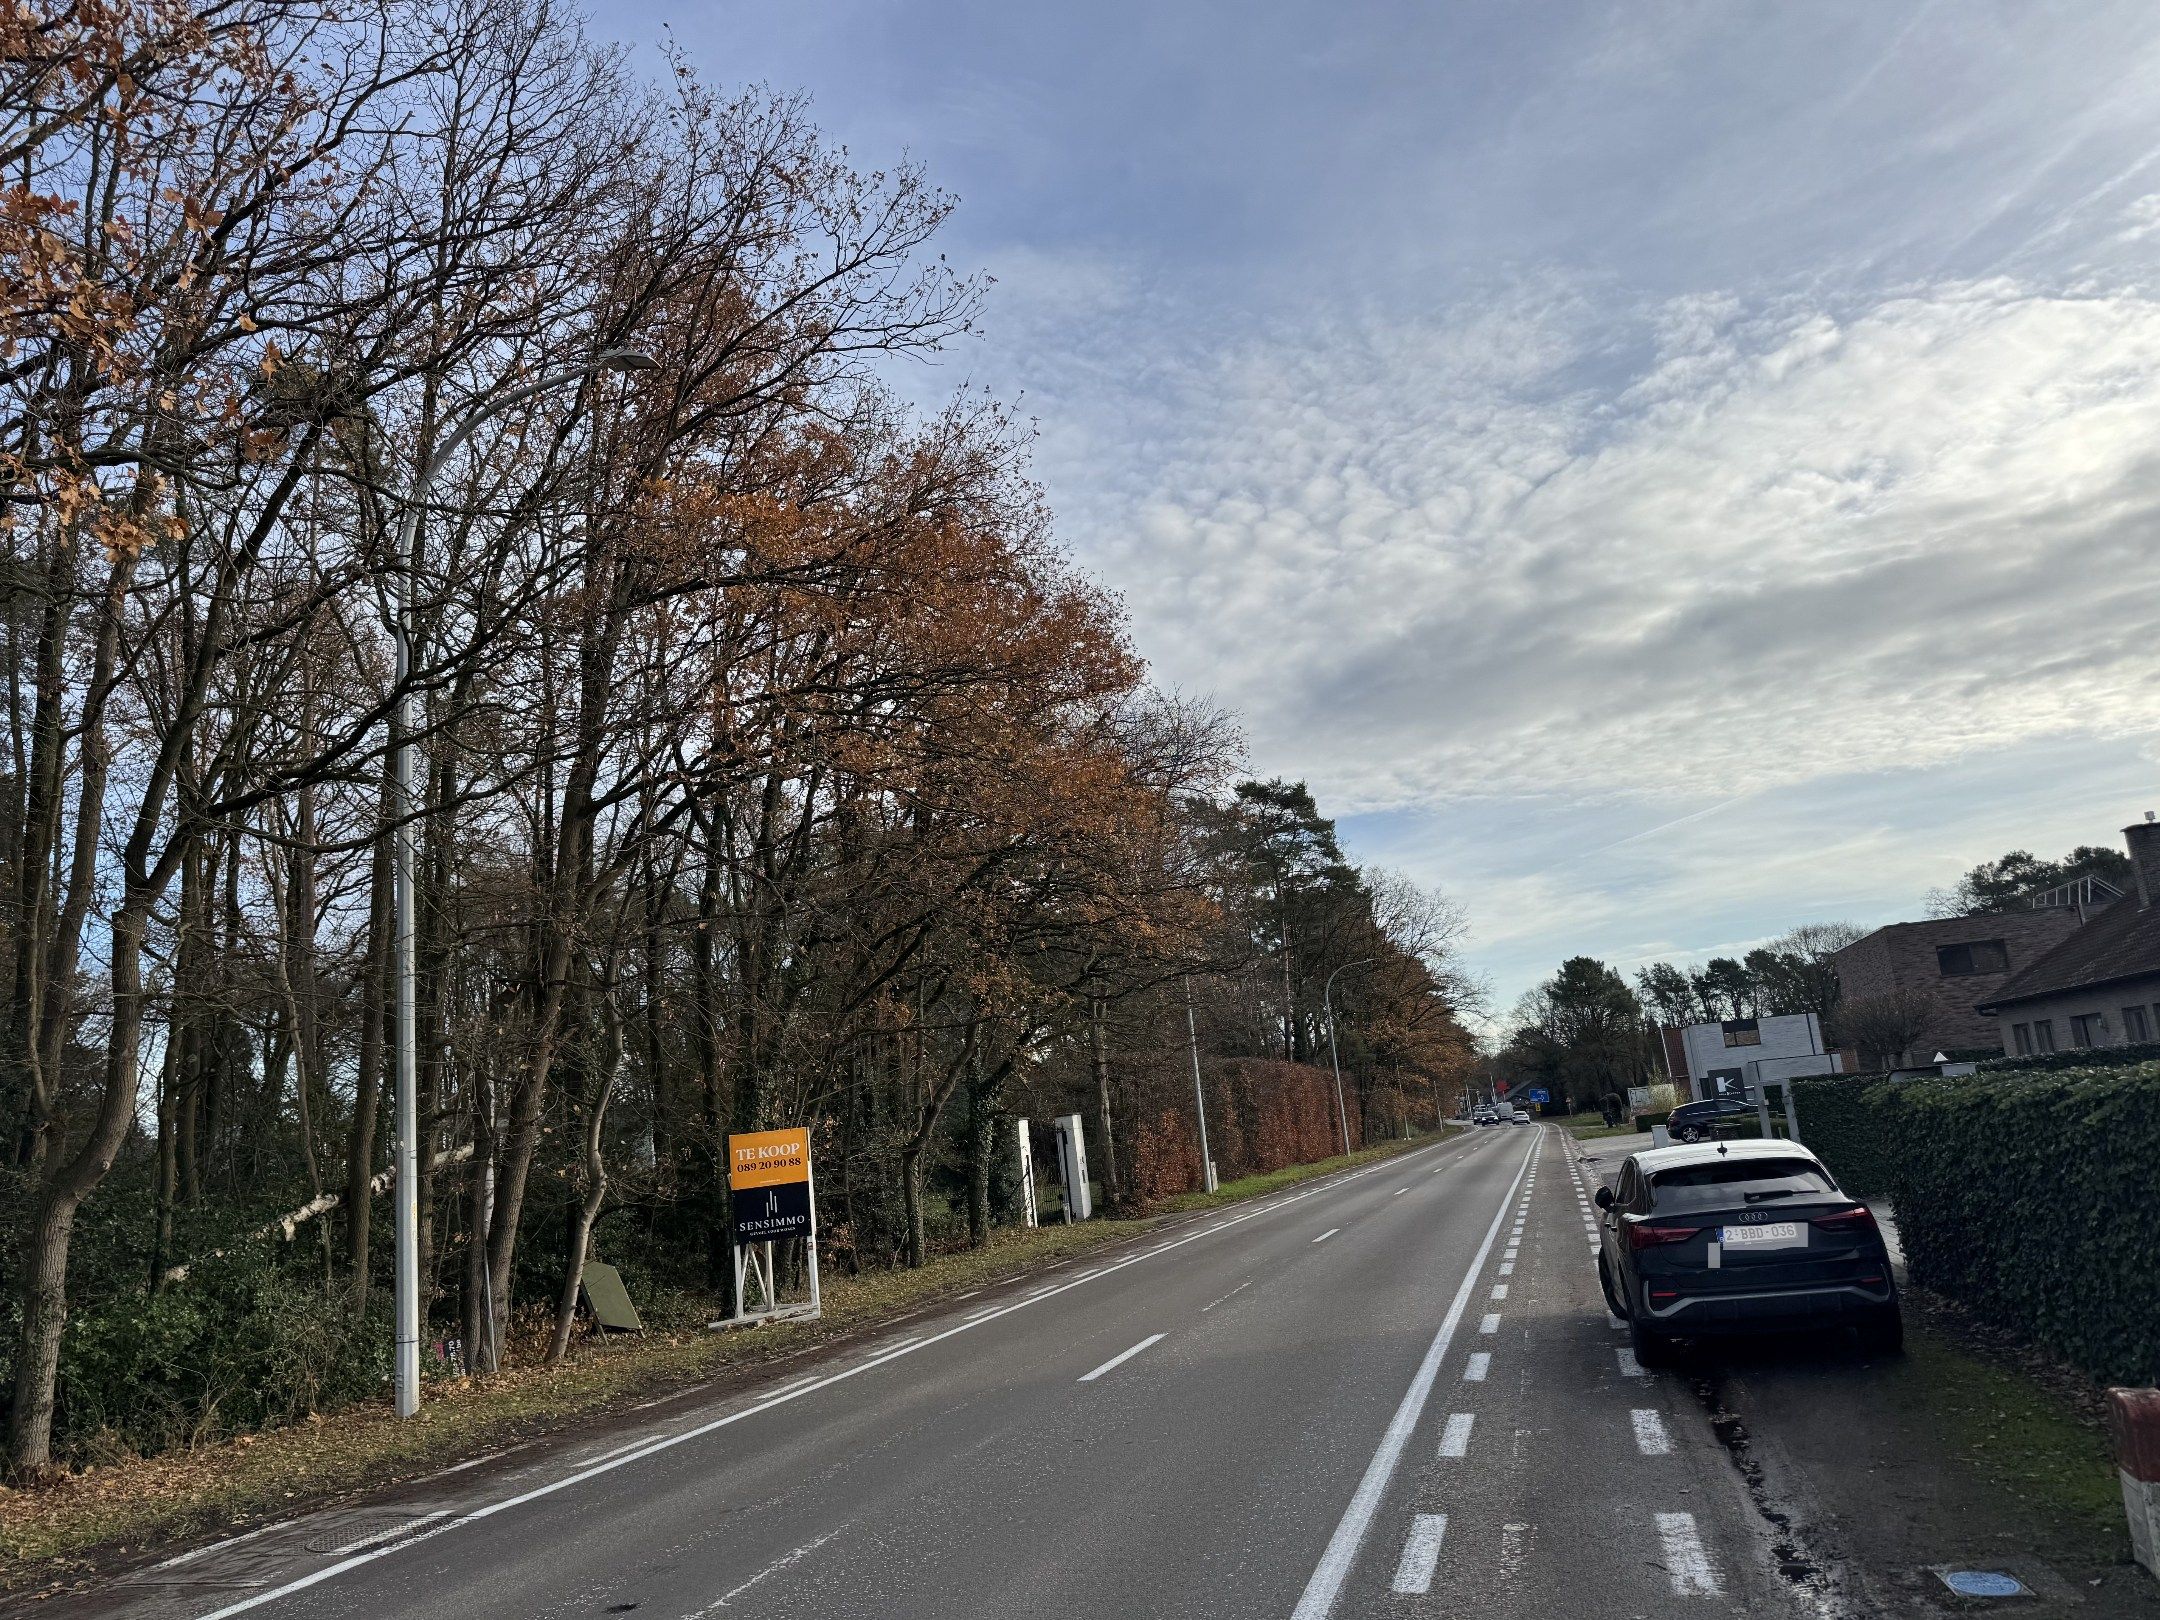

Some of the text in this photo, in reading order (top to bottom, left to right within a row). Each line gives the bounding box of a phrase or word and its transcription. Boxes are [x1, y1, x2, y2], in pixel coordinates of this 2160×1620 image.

[736, 1142, 800, 1160] TE KOOP
[737, 1157, 802, 1172] 089 20 90 88
[739, 1215, 805, 1232] SENSIMMO
